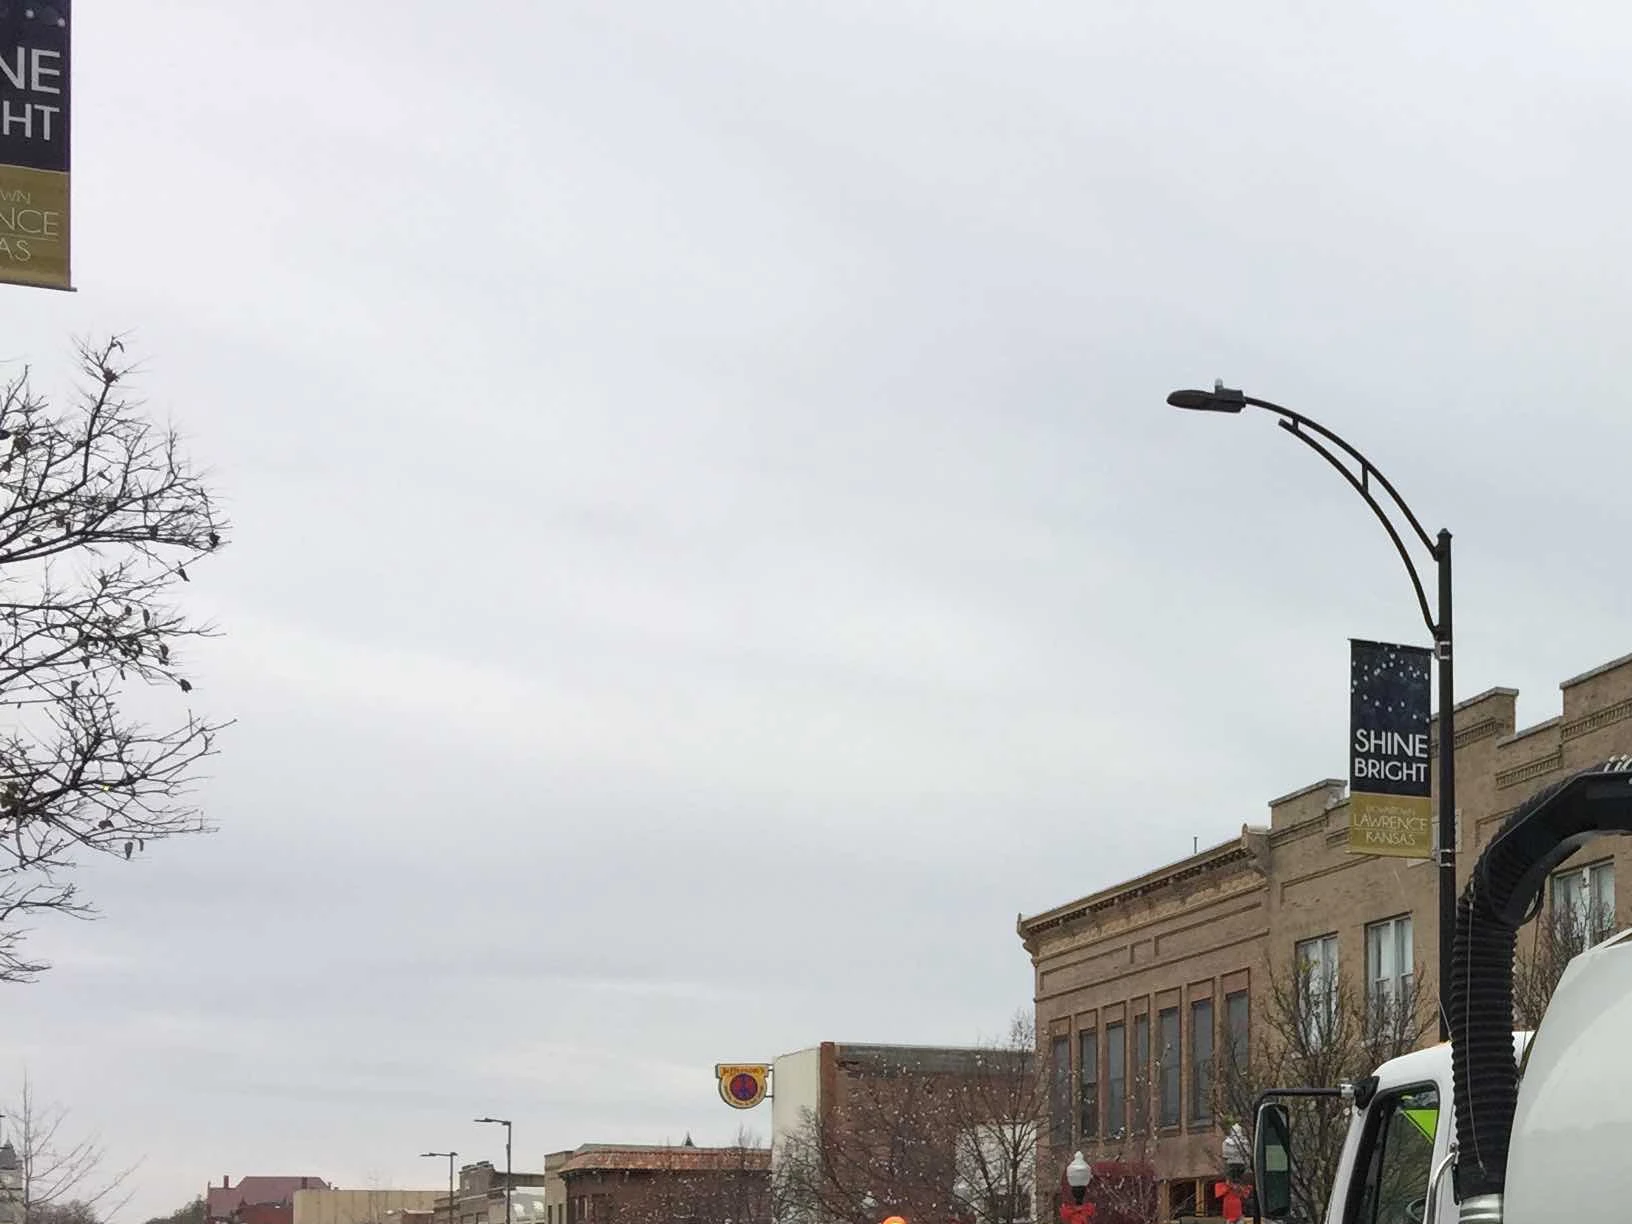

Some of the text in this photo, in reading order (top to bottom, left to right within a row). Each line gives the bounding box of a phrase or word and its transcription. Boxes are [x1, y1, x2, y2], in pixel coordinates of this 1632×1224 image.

[3, 101, 60, 141] HT
[1354, 728, 1428, 758] SHINE
[1354, 758, 1428, 783] BRIGHT
[1353, 813, 1429, 832] LAWRENCE
[1366, 831, 1416, 846] KANSAS
